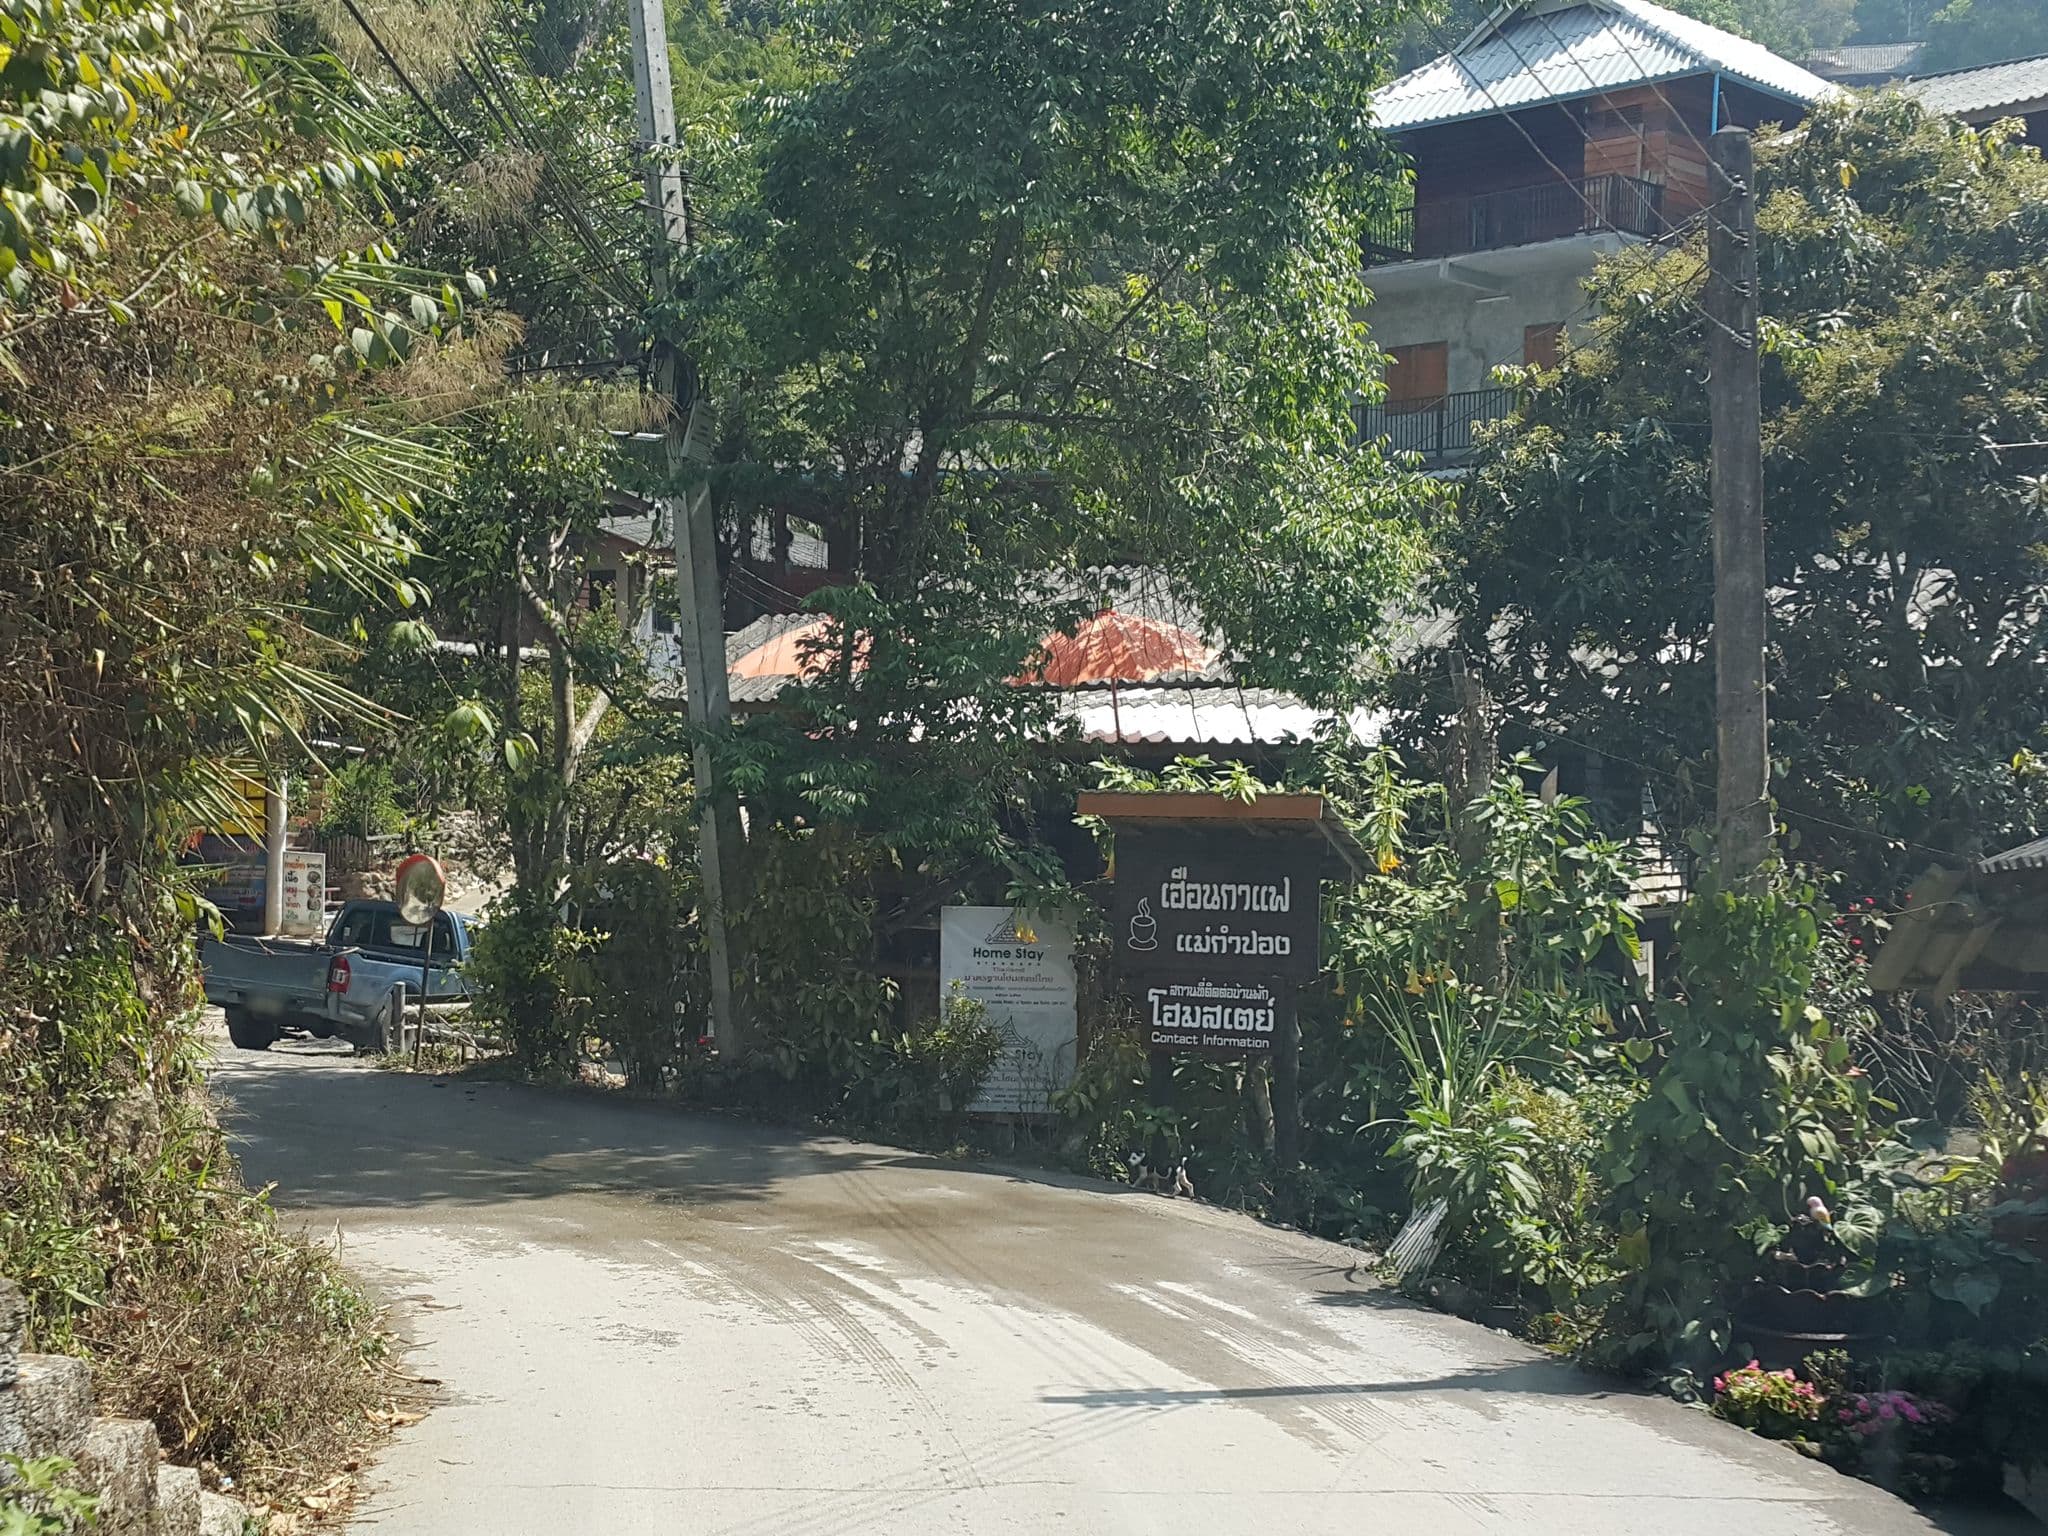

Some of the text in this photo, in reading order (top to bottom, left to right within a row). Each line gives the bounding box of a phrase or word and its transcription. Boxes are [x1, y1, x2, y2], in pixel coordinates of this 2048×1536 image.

[1161, 866, 1290, 912] เฮือนกาแฟ
[1176, 925, 1290, 955] แม่กำปอง
[973, 948, 1044, 961] Home Stay
[1169, 977, 1270, 1001] สถานที่ติดต่อบ้านพัก
[1148, 988, 1276, 1032] โฮมสเตย์
[1151, 1032, 1270, 1049] Contact Information
